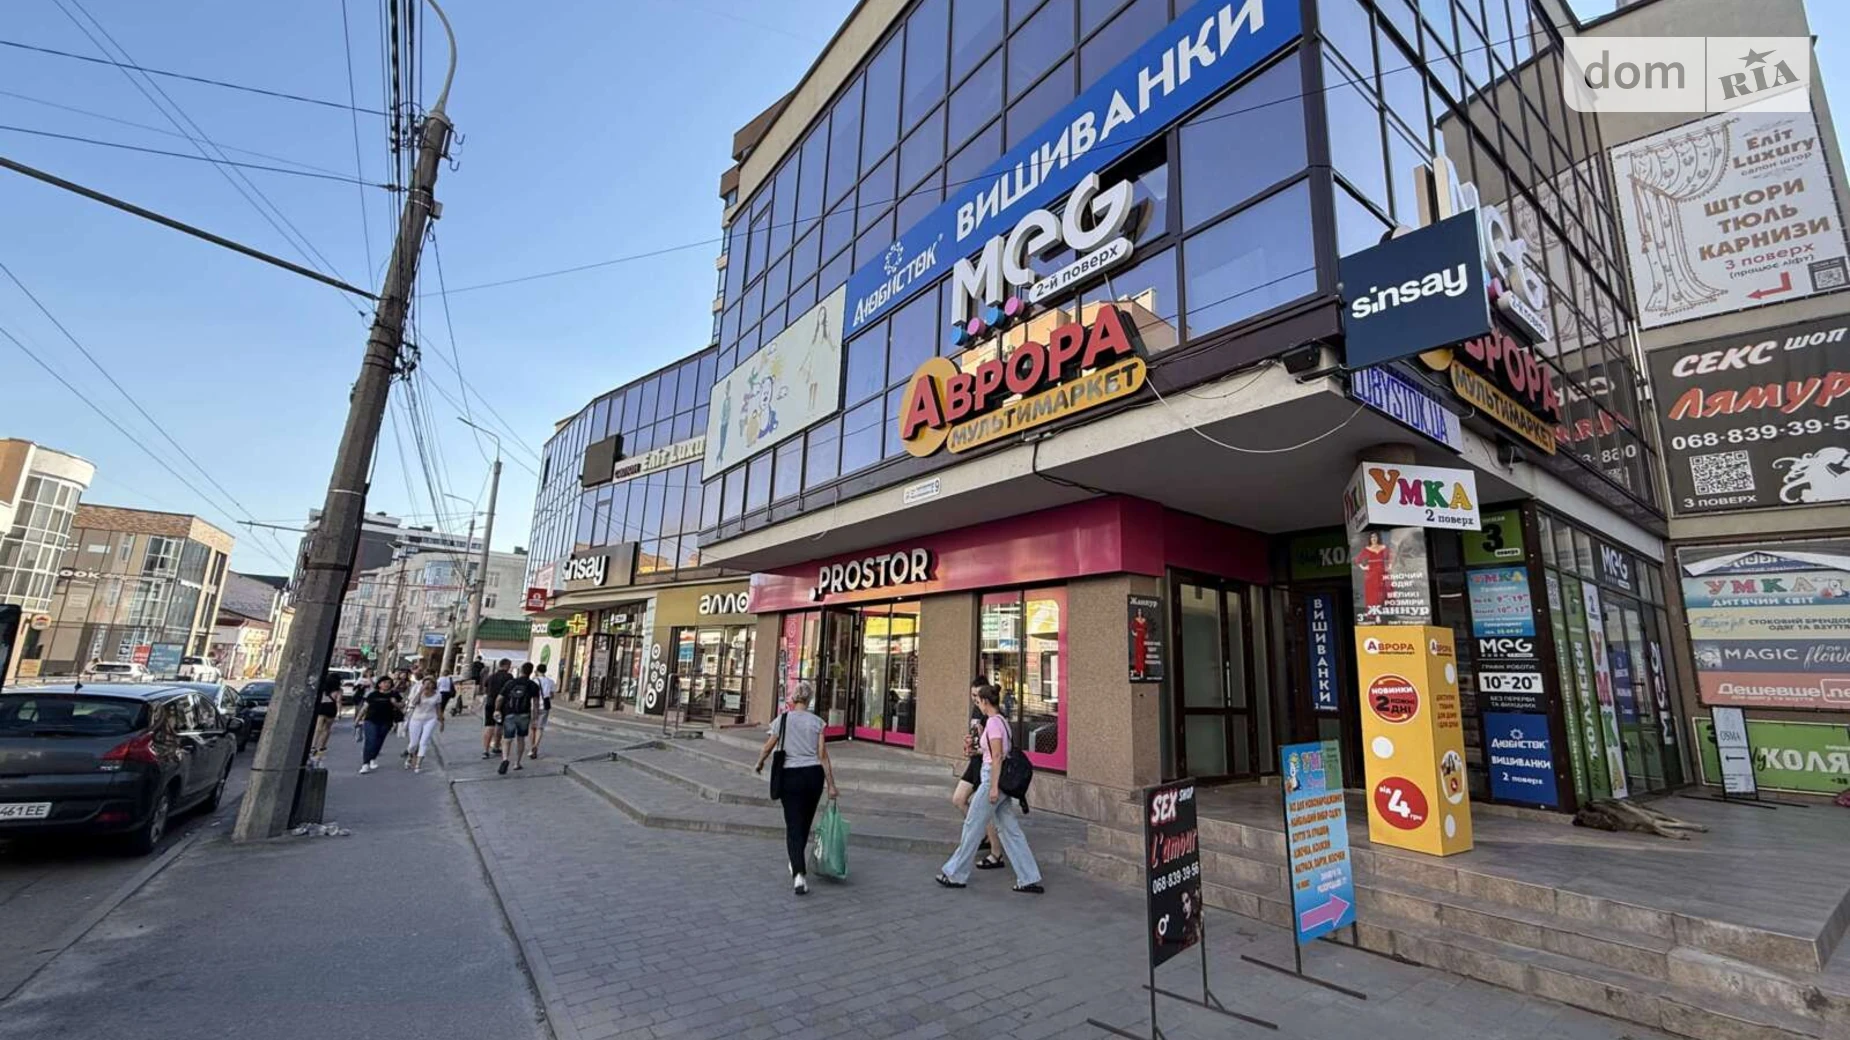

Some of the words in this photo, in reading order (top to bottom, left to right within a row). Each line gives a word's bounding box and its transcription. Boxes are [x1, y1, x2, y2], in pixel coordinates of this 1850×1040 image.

[956, 0, 1265, 243] ВИШИВАНКИ
[1732, 136, 1816, 170] Luxury
[1740, 161, 1777, 177] салон
[1779, 151, 1813, 169] штор
[1703, 177, 1806, 218] ШТОРИ
[1717, 203, 1799, 234] ТЮЛЬ
[1698, 215, 1832, 262] КАРНИЗИ
[1035, 275, 1058, 298] 2-й
[1061, 244, 1119, 281] поверх
[1725, 259, 1736, 271] 3
[1741, 242, 1815, 269] поверх
[1352, 263, 1469, 319] sinsay
[1671, 340, 1779, 378] СЕКС
[1783, 327, 1848, 351] шоп
[902, 304, 1132, 440] АВРОРА
[950, 361, 1140, 449] МУЛЬТИМАРКЕТ
[1453, 362, 1556, 450] МУЛЬТИМАРКЕТ
[1368, 467, 1473, 511] УМКА
[1684, 497, 1695, 508] 3
[1425, 508, 1435, 522] 2
[1438, 514, 1474, 528] поверх
[1481, 523, 1504, 553] 3
[1703, 576, 1817, 596] УМКА
[1367, 605, 1430, 616] Жаннур
[1311, 598, 1331, 703] ВИШИВАНКИ
[1366, 640, 1415, 652] АВРОРА
[1724, 648, 1799, 660] MAGIC
[1371, 685, 1414, 695] НОВИНКИ
[1375, 695, 1390, 712] 2
[1718, 683, 1822, 697] Дешевше
[1390, 703, 1412, 714] ДНІ
[1491, 755, 1552, 769] ВИШИВАНКИ
[1502, 772, 1509, 781] 2
[1150, 788, 1179, 825] SEX
[1388, 789, 1411, 818] 4
